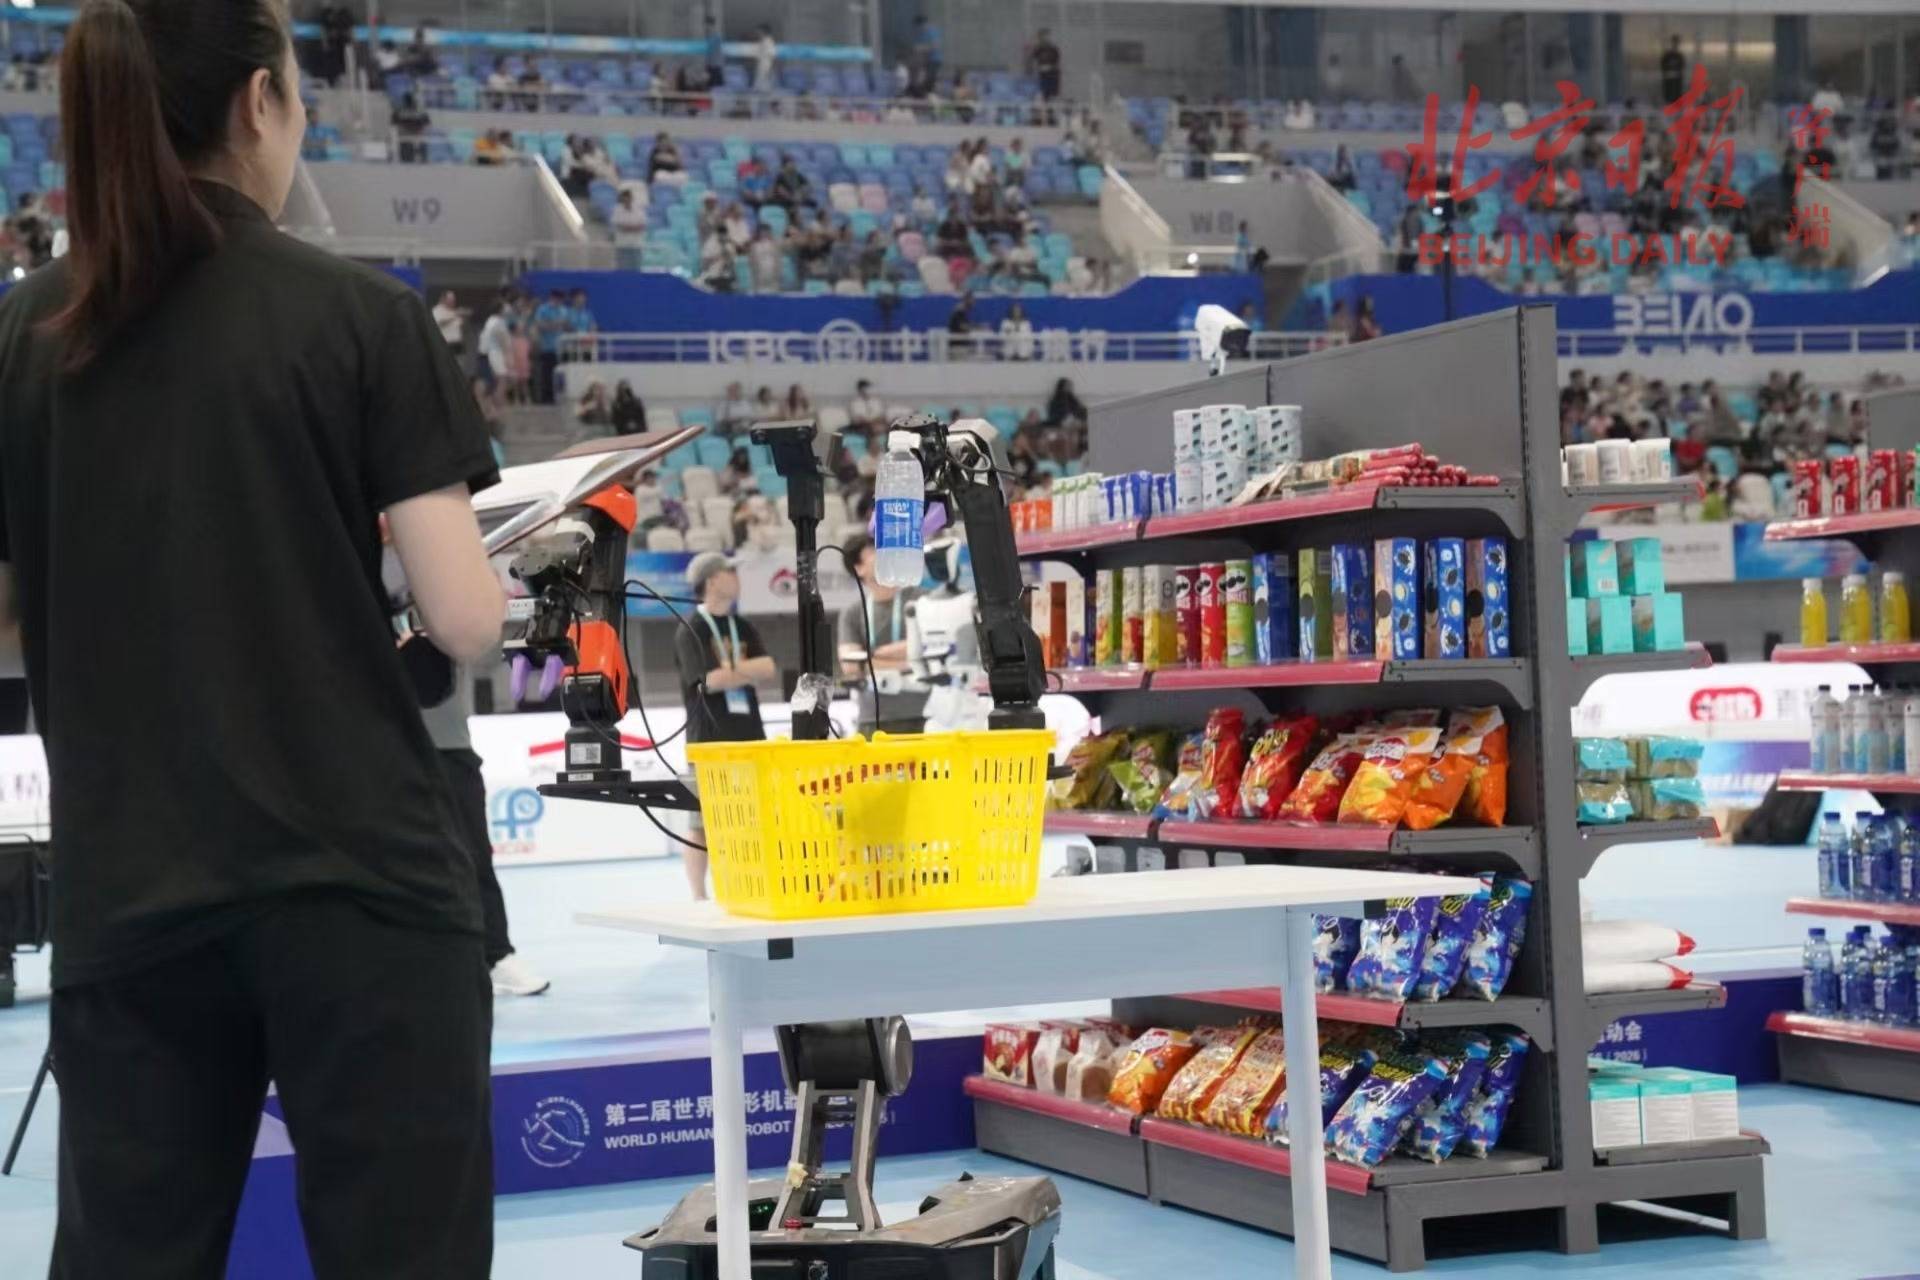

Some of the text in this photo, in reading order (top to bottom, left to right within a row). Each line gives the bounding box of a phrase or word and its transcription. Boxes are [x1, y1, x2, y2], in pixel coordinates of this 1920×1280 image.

[392, 197, 442, 224] W9
[708, 330, 806, 362] ICBC
[603, 1132, 658, 1149] WORLD
[660, 1127, 715, 1144] HUMAN
